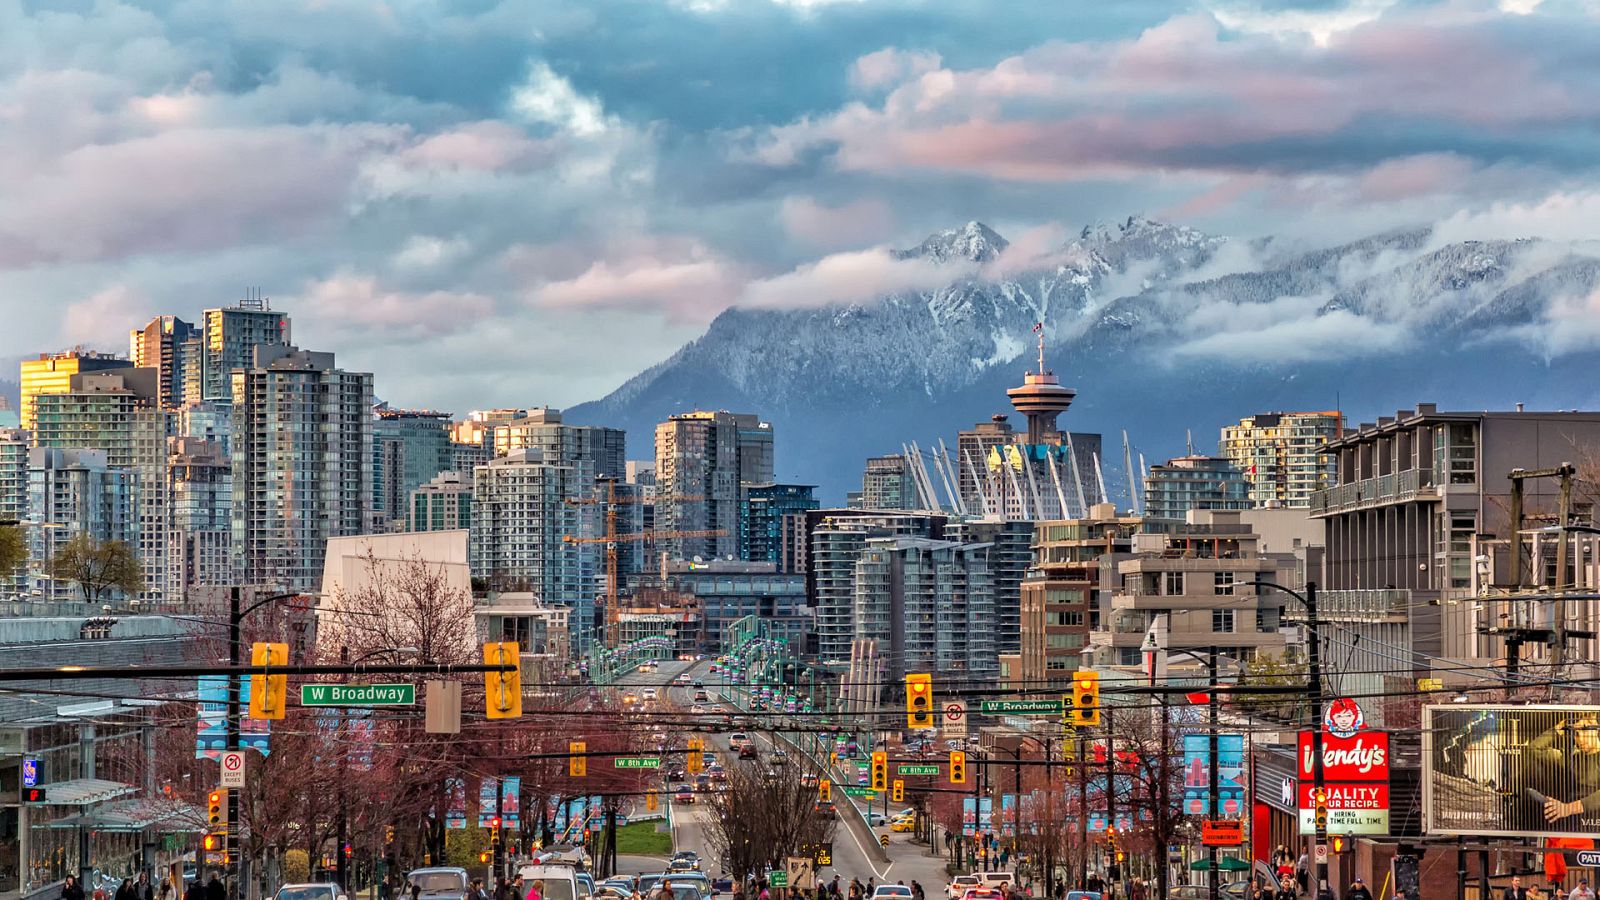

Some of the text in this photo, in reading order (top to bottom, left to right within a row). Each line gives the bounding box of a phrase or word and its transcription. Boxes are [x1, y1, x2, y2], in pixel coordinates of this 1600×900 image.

[312, 687, 405, 702] W Broadway
[1003, 702, 1057, 712] Broadway
[1304, 739, 1385, 773] Wendy's
